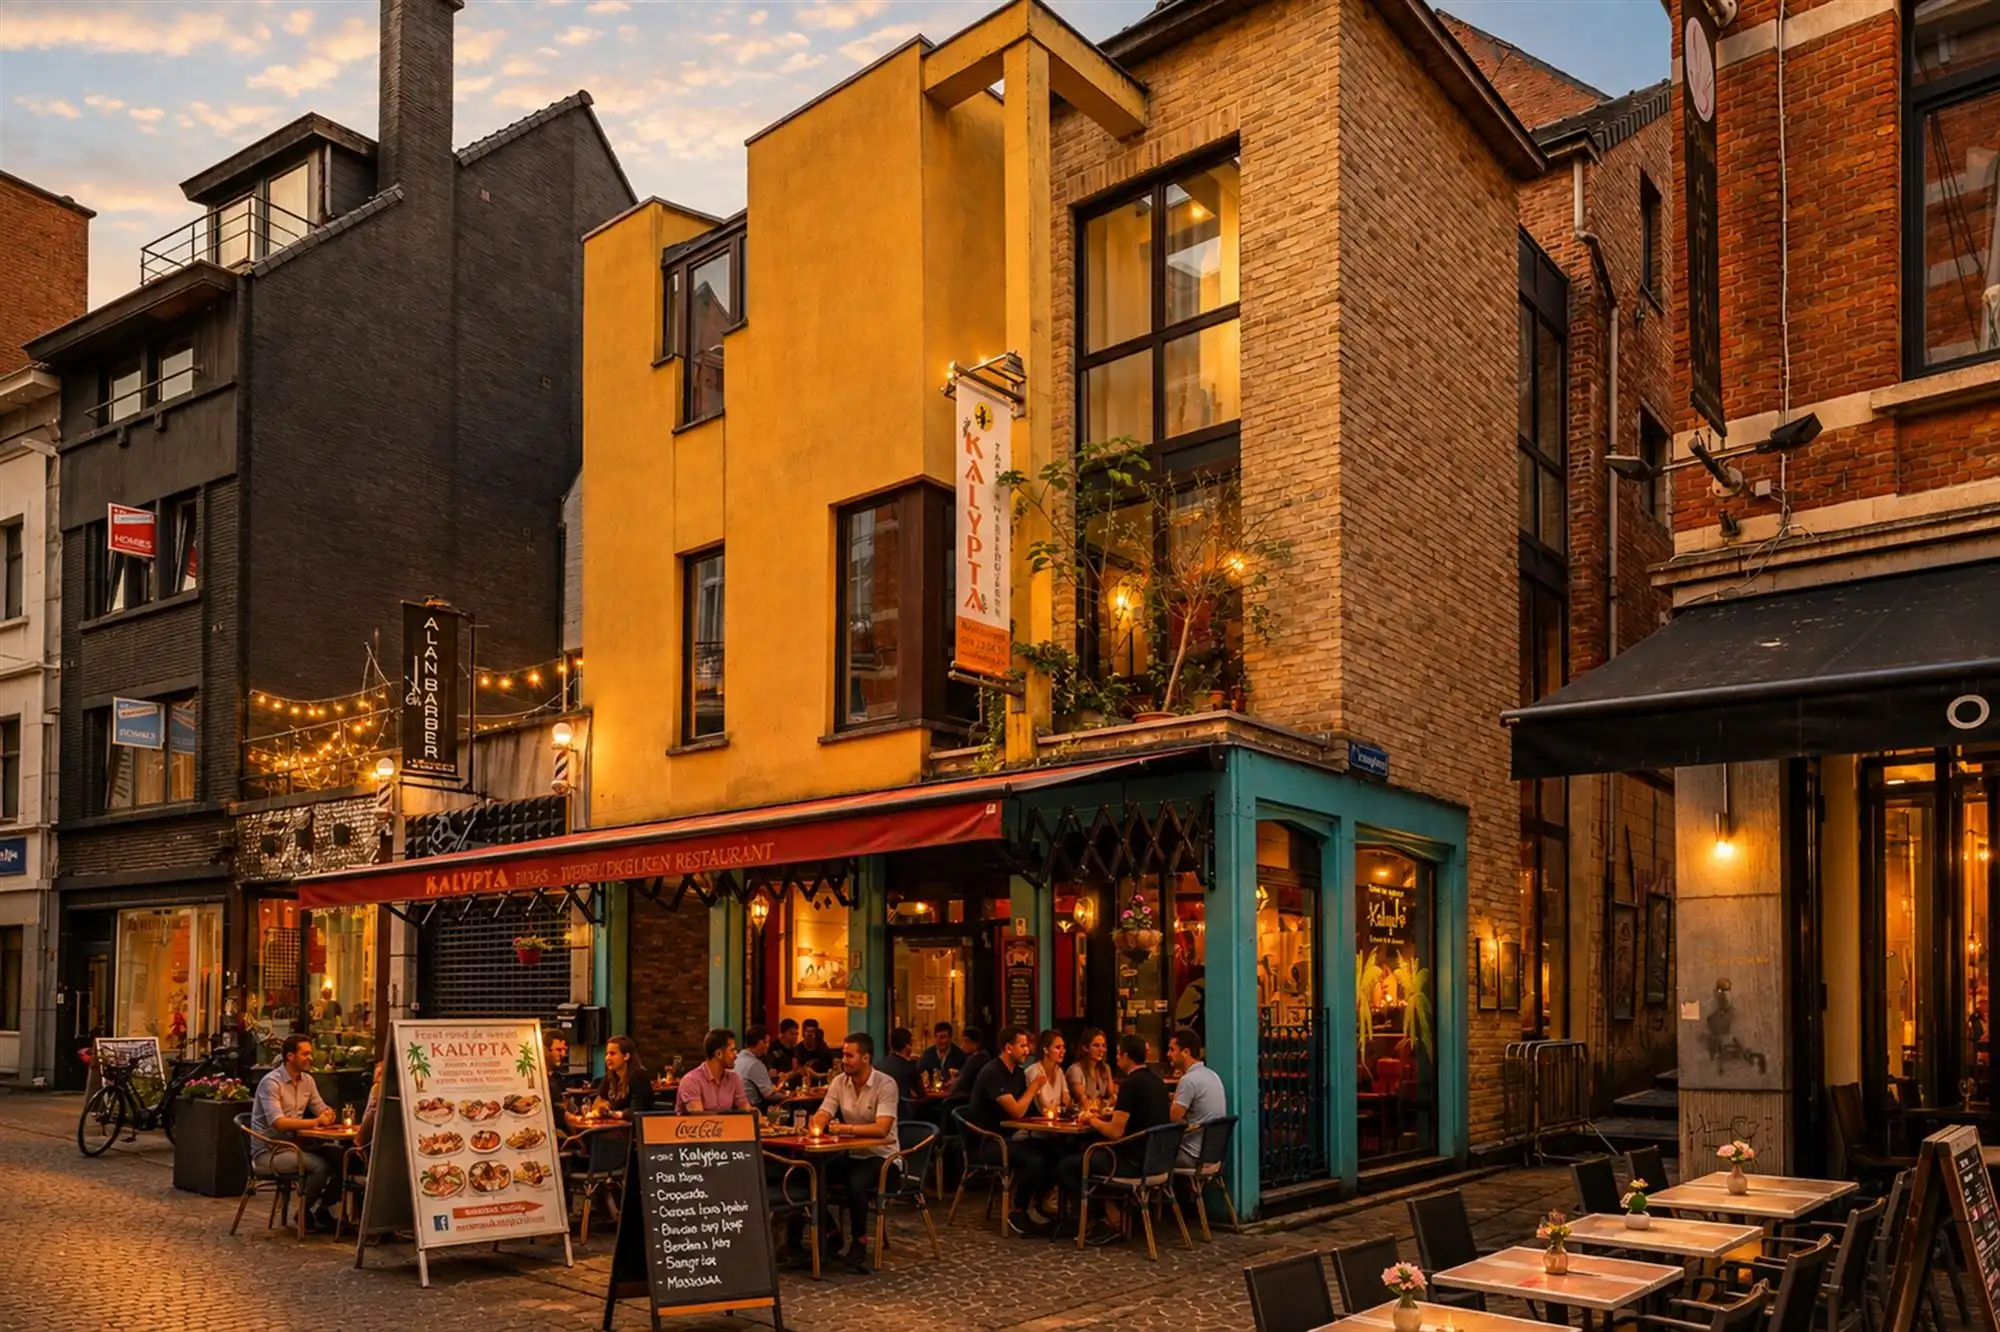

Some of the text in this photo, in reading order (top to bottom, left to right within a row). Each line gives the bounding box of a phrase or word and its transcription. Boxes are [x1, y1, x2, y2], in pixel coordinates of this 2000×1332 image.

[963, 431, 985, 613] KALYPTA
[426, 869, 509, 895] KALYPTA
[675, 842, 775, 870] RESTAURANT
[431, 1041, 513, 1058] KALYPTA
